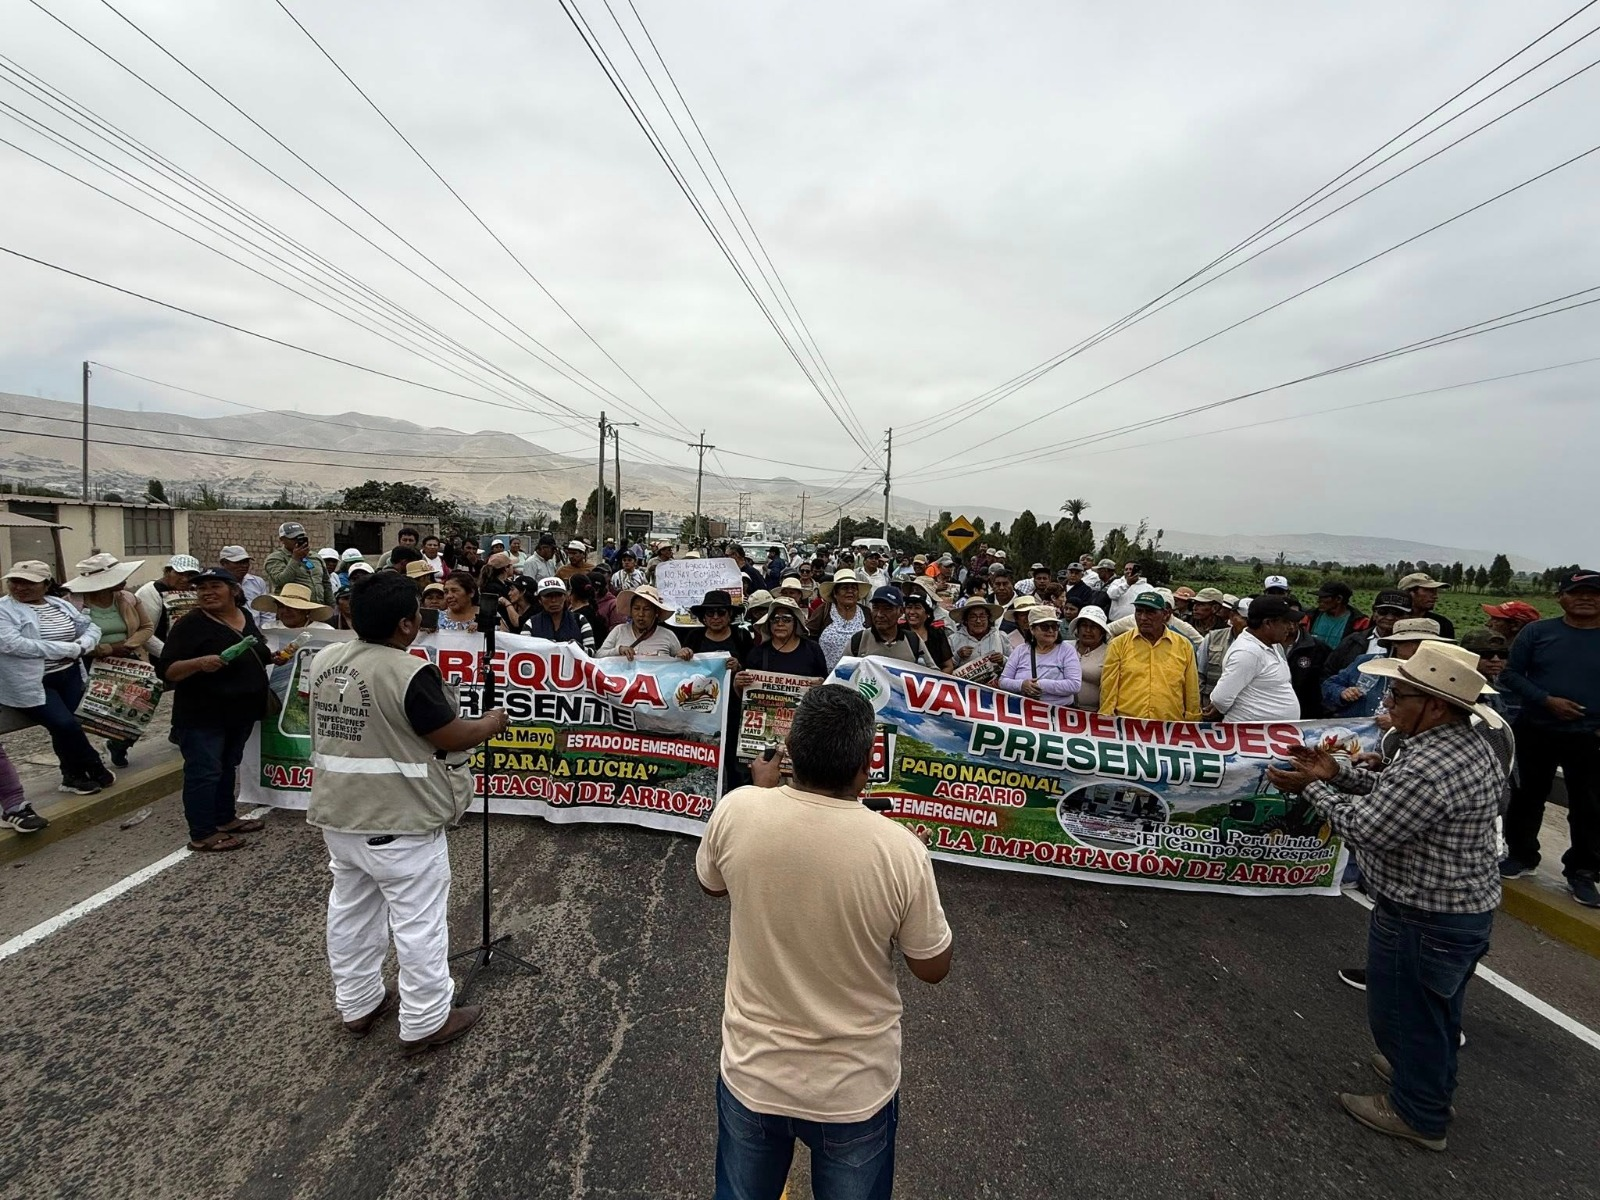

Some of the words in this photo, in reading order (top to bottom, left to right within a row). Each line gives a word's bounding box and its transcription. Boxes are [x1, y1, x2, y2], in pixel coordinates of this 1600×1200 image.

[92, 680, 113, 696] 25
[314, 665, 349, 688] REPORTERO
[357, 680, 371, 707] PUEBLO
[751, 674, 775, 684] VALLE
[774, 676, 785, 685] DE
[762, 682, 801, 693] PRESENTE
[342, 705, 370, 718] OFICIAL
[459, 688, 637, 731] RSENTE
[744, 710, 763, 728] 25
[775, 707, 795, 720] ALT
[901, 673, 1050, 731] VALLE
[1056, 705, 1117, 740] DE
[1122, 717, 1303, 761] MAJES
[516, 729, 553, 746] Mayo
[566, 734, 622, 750] ESTADO
[622, 737, 641, 752] DE
[640, 739, 716, 764] EMERGENCIA
[493, 752, 549, 771] PARA
[549, 757, 571, 777] LA
[968, 721, 1226, 789] PRESENTE
[901, 757, 957, 782] PARO
[959, 765, 1064, 795] NACIONAL
[577, 781, 616, 804] DE
[933, 780, 1027, 808] AGRARIO
[902, 798, 998, 828] EMERGENCIA
[1151, 821, 1198, 840] Todo
[1200, 826, 1220, 842] el
[1227, 829, 1272, 847] Perú
[1273, 834, 1323, 850] Unido
[937, 827, 976, 852] LA
[982, 835, 1183, 878] IMPORTACIÓN
[1184, 859, 1227, 882] DE
[1164, 835, 1238, 859] Campo
[1238, 847, 1264, 860] se
[1265, 845, 1336, 865] Respeta!
